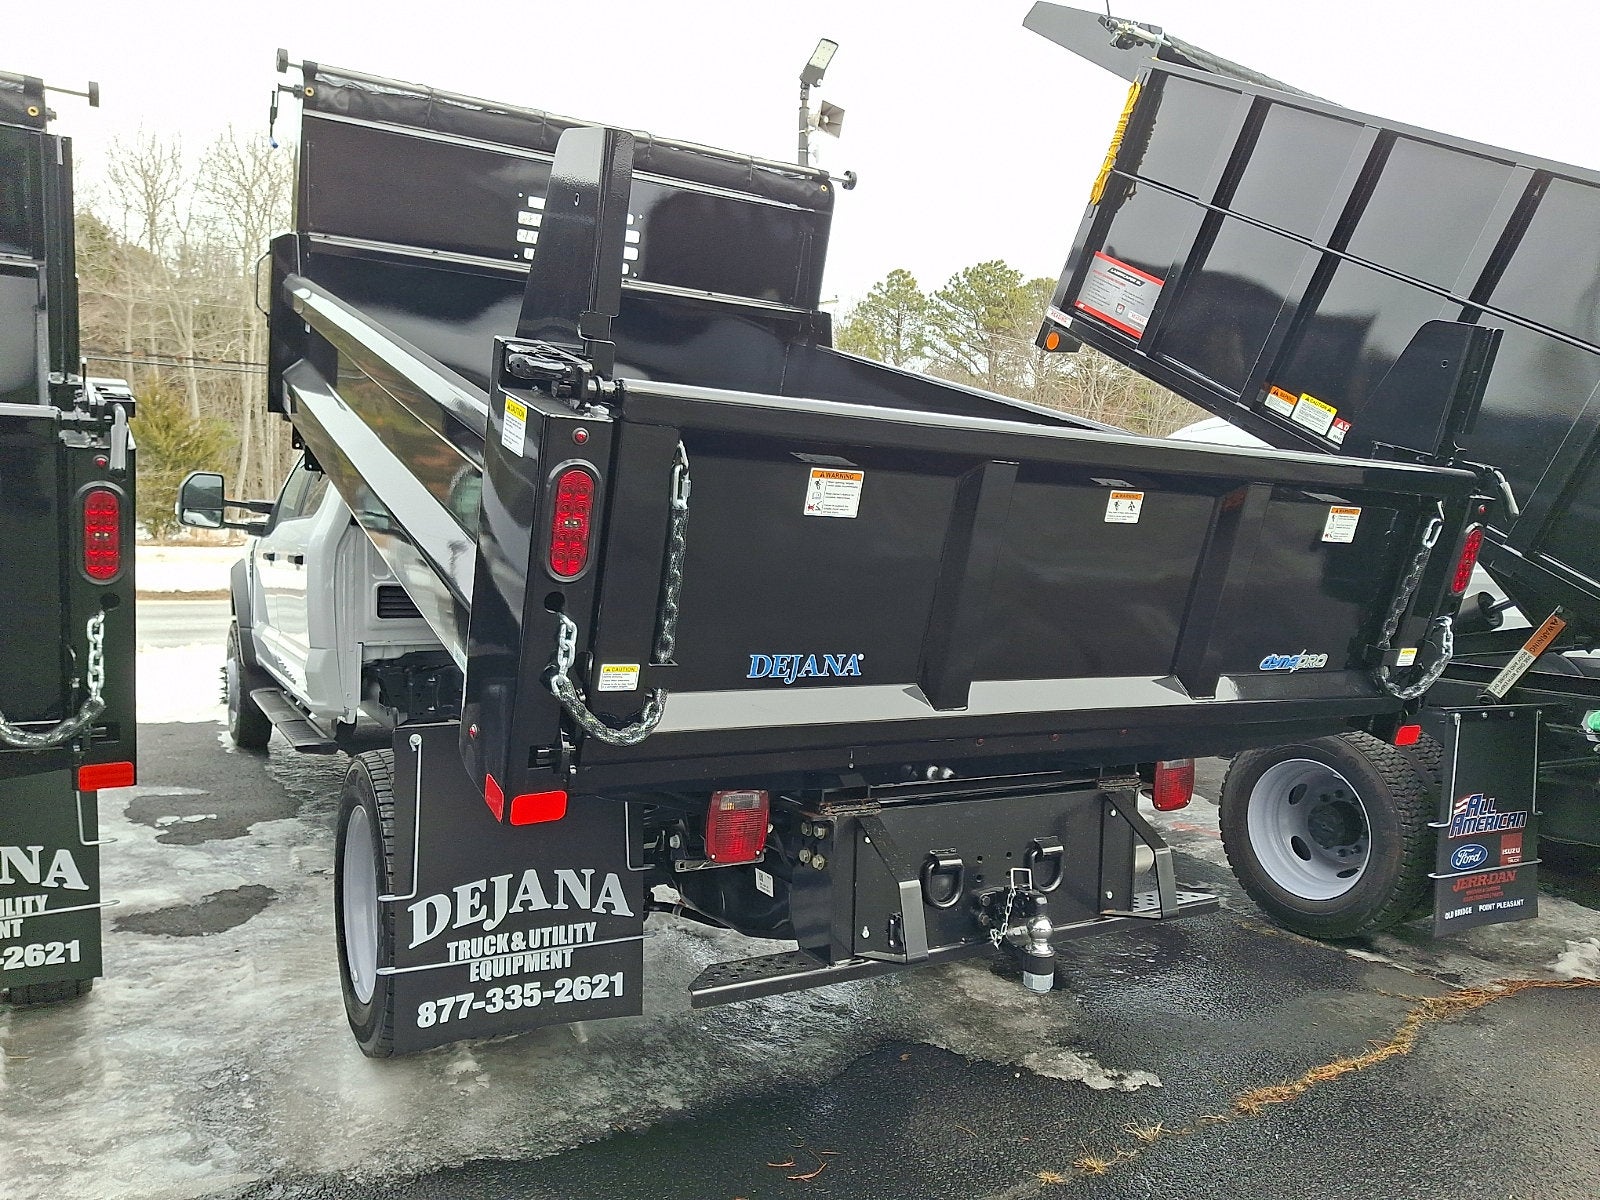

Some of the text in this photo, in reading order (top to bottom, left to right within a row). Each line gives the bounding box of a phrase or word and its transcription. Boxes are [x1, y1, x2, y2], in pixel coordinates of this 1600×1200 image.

[826, 471, 854, 480] WARNING
[1529, 625, 1555, 653] WARNING
[1465, 793, 1496, 818] ALL
[1455, 848, 1482, 866] Ford
[1502, 847, 1521, 855] ISUZU
[407, 869, 634, 949] DEJANA
[1478, 903, 1495, 912] POINT
[1496, 899, 1525, 909] PLEASANT
[470, 949, 574, 982] EQUIPMENT
[417, 972, 624, 1028] 877-335-2621
